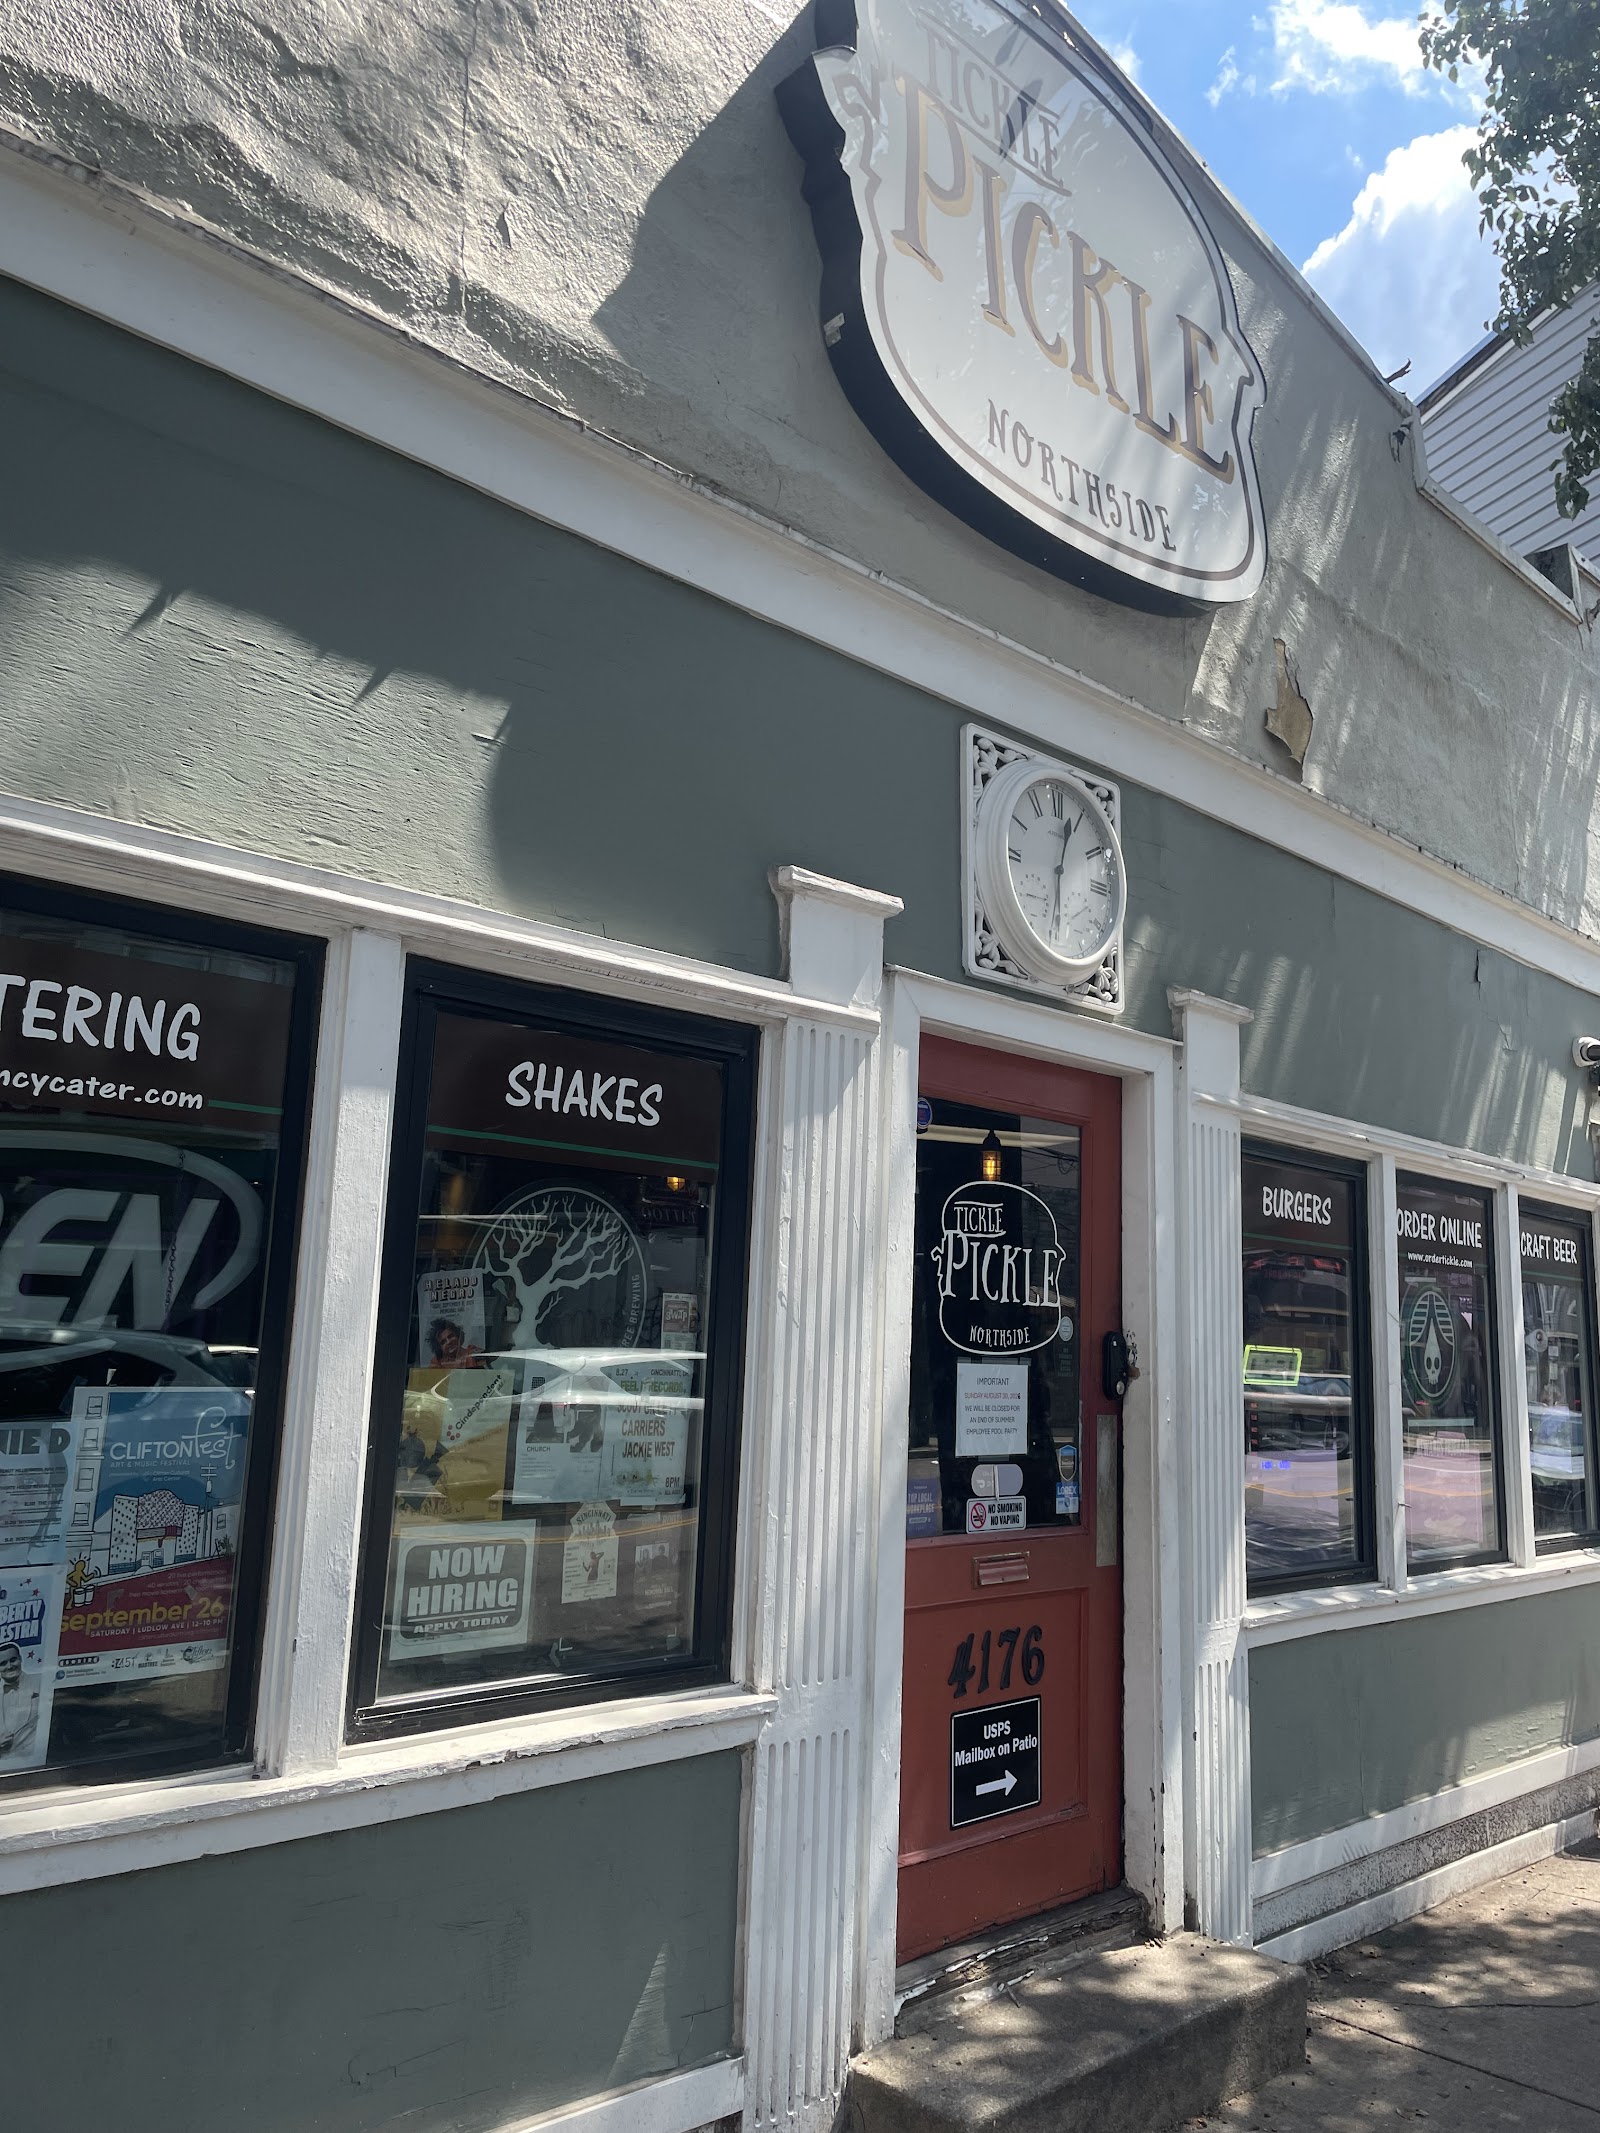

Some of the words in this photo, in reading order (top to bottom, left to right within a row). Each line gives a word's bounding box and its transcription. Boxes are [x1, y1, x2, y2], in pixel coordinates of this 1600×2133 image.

[925, 24, 1065, 190] TICKLE
[891, 76, 1235, 484] PICKLE
[988, 398, 1177, 552] NORTHSIDE
[505, 1061, 663, 1127] SHAKES
[1262, 1186, 1333, 1226] BURGERS
[953, 1206, 1004, 1233] TICKLE
[1396, 1207, 1437, 1241] ORDER
[1440, 1215, 1482, 1249] ONLINE
[0, 1188, 220, 1331] EN
[1407, 1252, 1473, 1268] www.ordertickle.com
[1521, 1231, 1551, 1260] CRAFT
[1553, 1237, 1578, 1265] BEER
[941, 1229, 1061, 1307] PICKLE
[424, 1276, 479, 1292] HELADO
[430, 1287, 475, 1303] NEGRO
[628, 1273, 641, 1324] BREWING
[970, 1325, 1031, 1348] NORTHSIDE
[621, 1381, 639, 1392] FEEL
[976, 1378, 1010, 1386] IMPORTANT
[455, 1374, 503, 1430] Cindependent
[964, 1392, 983, 1400] SUNDAY
[621, 1420, 666, 1437] CARRIERS
[1005, 1427, 1018, 1435] PARTY
[622, 1441, 652, 1458] JACKIE
[654, 1441, 675, 1457] WEST
[665, 1476, 680, 1489] 8PM
[1057, 1486, 1077, 1496] LOREX
[987, 1504, 996, 1514] NO
[997, 1503, 1023, 1513] SMOKING
[990, 1516, 999, 1526] NO
[999, 1514, 1020, 1525] VAPING
[428, 1545, 506, 1579] NOW
[407, 1577, 519, 1617] HIRING
[61, 1601, 193, 1636] september
[197, 1597, 225, 1619] 26
[414, 1621, 459, 1634] APPLY
[462, 1615, 509, 1628] TODAY
[0, 1619, 39, 1643] ESTRA
[90, 1627, 130, 1638] SATURDAY
[138, 1623, 169, 1633] LUDLOW
[170, 1622, 185, 1630] AVE
[948, 1625, 1045, 1699] 4176
[983, 1720, 1011, 1740] USPS
[954, 1745, 996, 1767] Mailbox
[998, 1741, 1010, 1756] on
[1012, 1734, 1038, 1753] Patio
